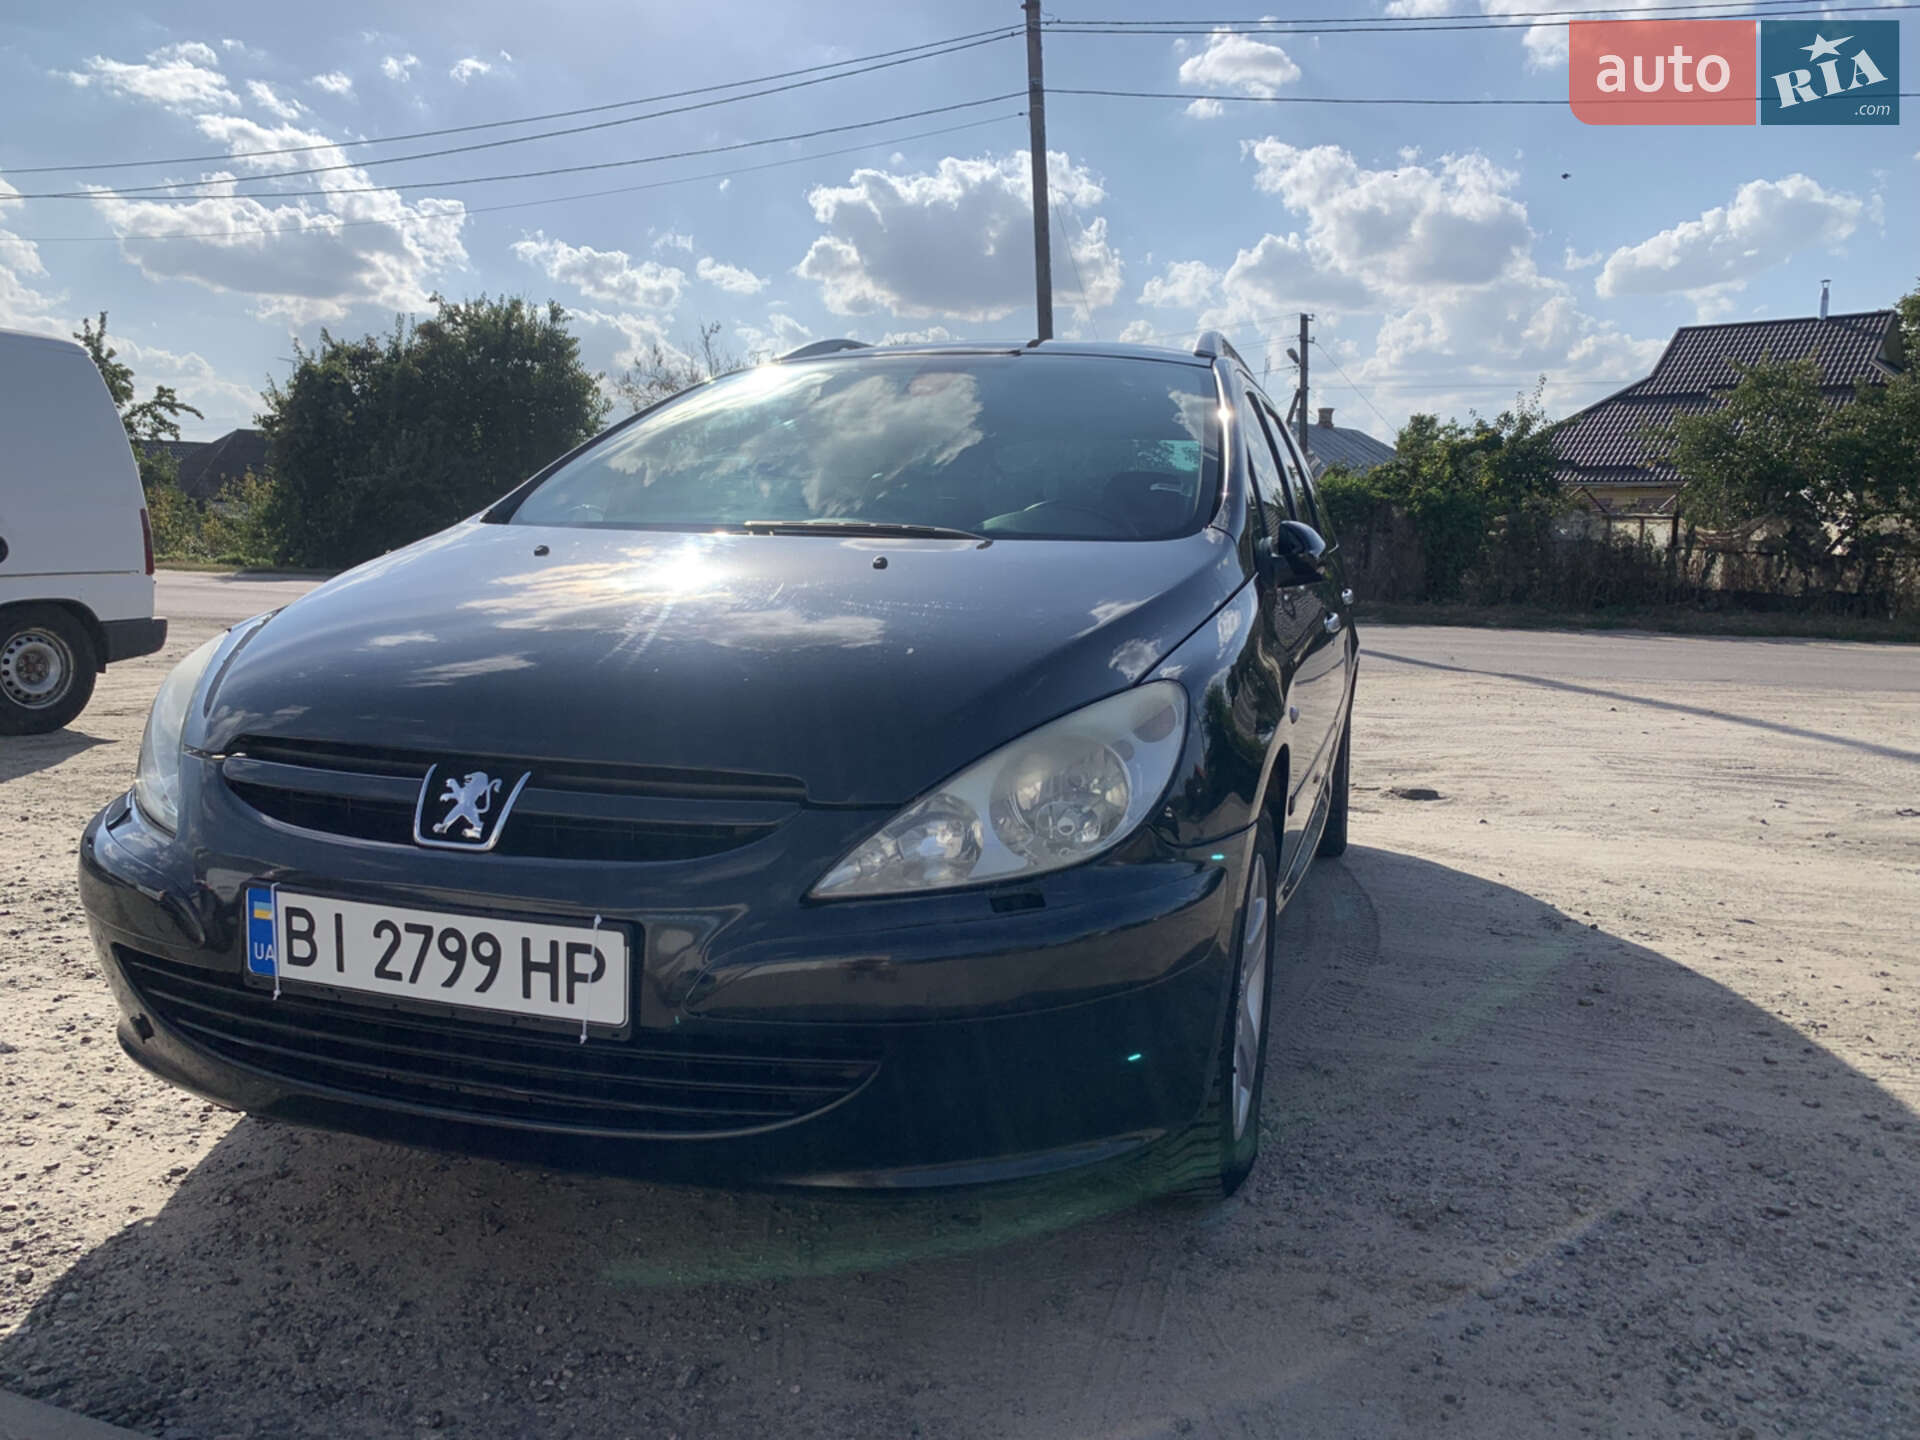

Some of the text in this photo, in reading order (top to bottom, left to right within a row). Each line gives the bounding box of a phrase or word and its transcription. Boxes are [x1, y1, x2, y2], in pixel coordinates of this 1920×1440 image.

[254, 942, 275, 961] UA
[284, 906, 606, 1004] BI 2799 HP
